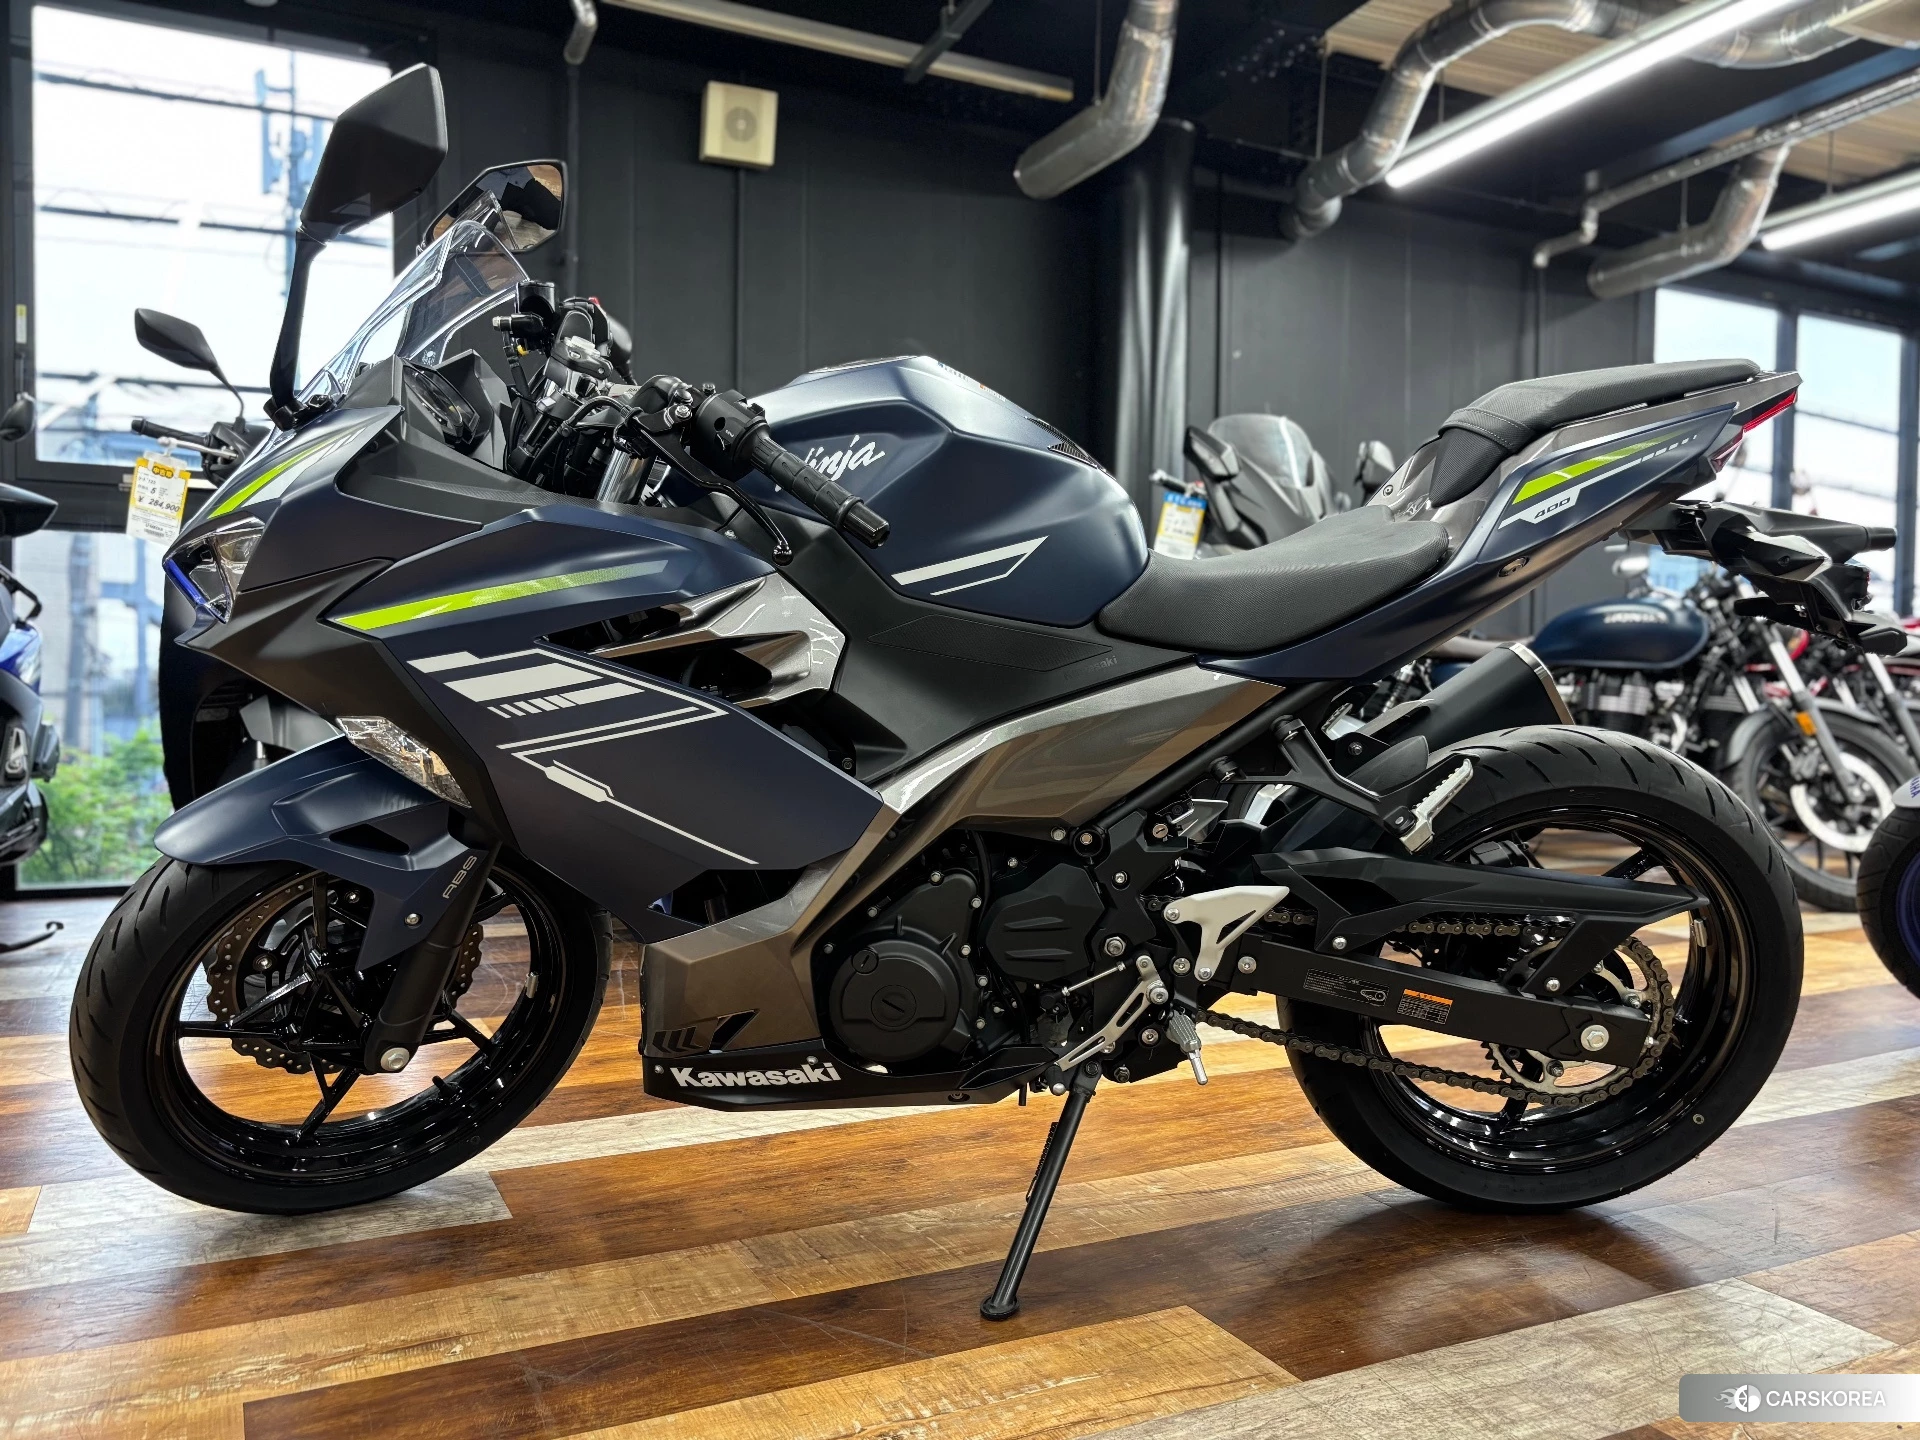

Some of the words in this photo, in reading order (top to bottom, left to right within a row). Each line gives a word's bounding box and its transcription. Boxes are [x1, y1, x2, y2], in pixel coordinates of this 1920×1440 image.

[775, 434, 886, 492] inja
[148, 498, 181, 513] 284,900
[1534, 497, 1571, 520] 400
[442, 855, 478, 899] ABS
[670, 1062, 842, 1087] Kawasaki
